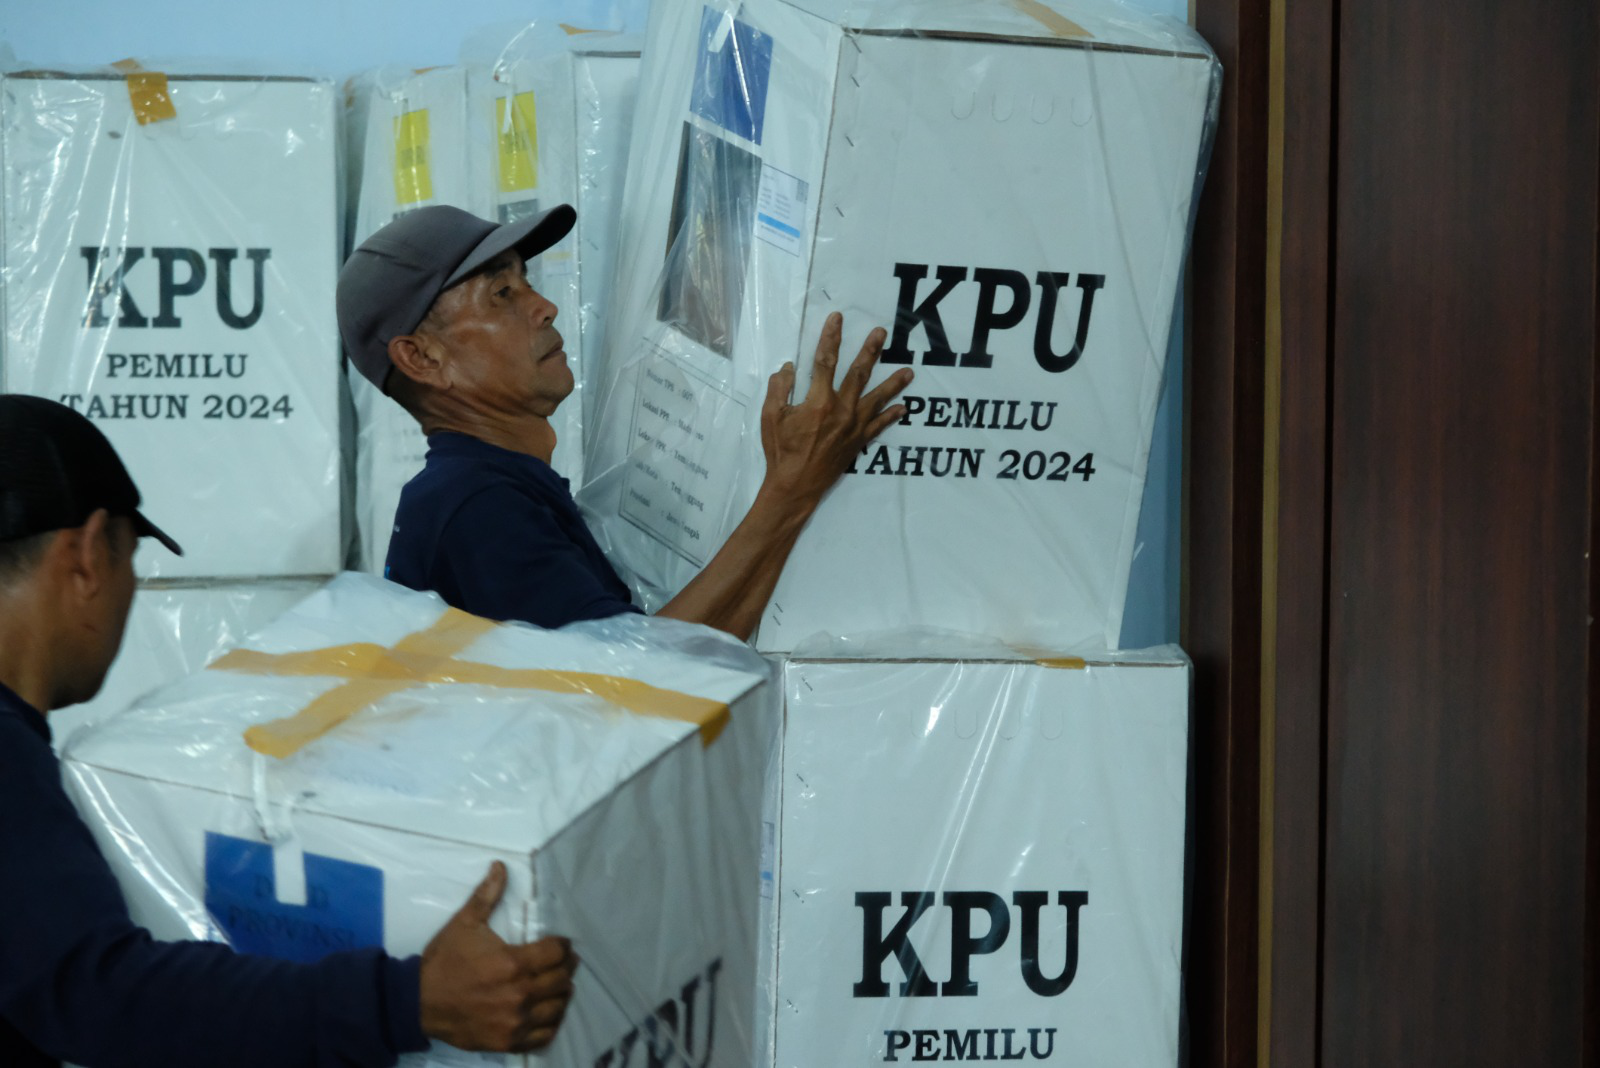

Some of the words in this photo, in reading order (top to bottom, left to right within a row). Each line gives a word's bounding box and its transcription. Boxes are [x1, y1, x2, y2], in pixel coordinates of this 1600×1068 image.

[80, 247, 271, 330] KPU
[879, 262, 1106, 373] KPU
[106, 354, 248, 378] PEMILU
[61, 395, 189, 419] TAHUN
[203, 395, 293, 419] 2024
[898, 396, 1058, 431] PEMILU
[996, 449, 1096, 481] 2024
[853, 890, 1089, 997] KPU
[883, 1028, 1057, 1062] PEMILU
